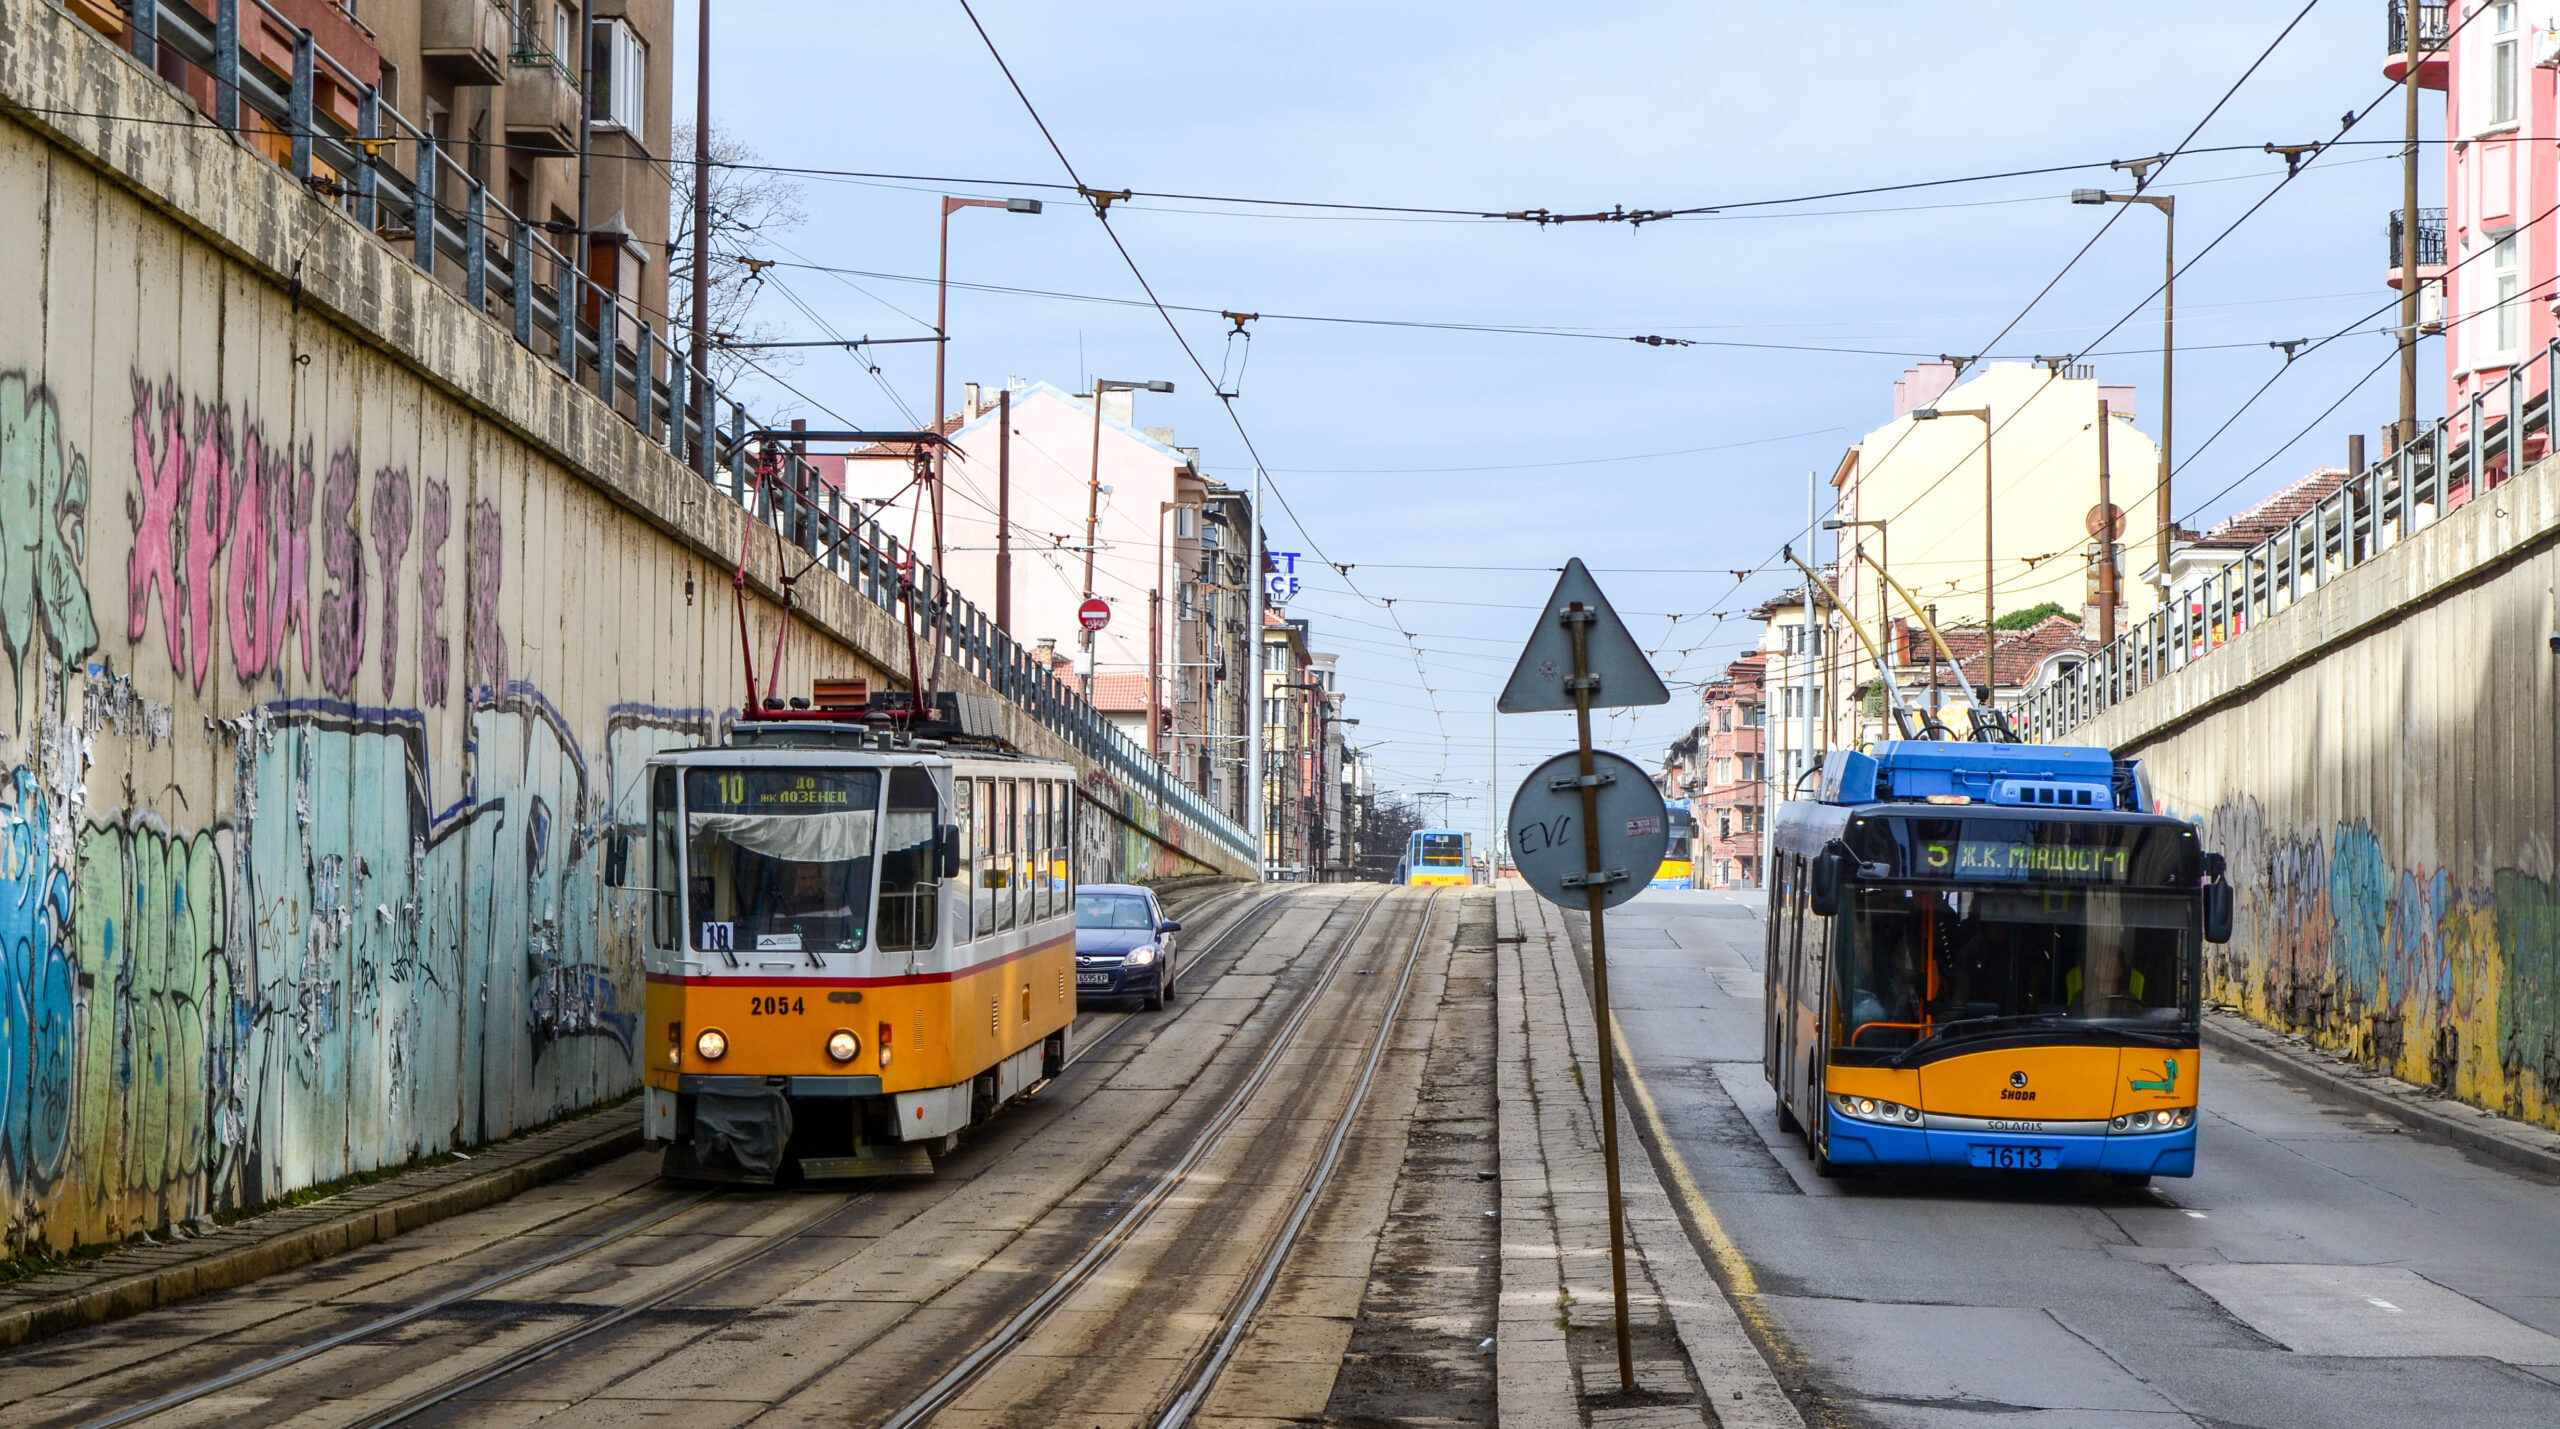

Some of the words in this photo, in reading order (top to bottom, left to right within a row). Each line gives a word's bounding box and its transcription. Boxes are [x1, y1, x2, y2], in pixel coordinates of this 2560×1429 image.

[718, 774, 744, 804] 10
[795, 777, 815, 789] ДО
[780, 791, 848, 804] ЛОЗЕНЕЦ
[707, 924, 728, 949] 10
[751, 996, 804, 1015] 2054
[2000, 1088, 2036, 1101] ŠKODA
[1987, 1120, 2043, 1132] SOLARIS
[1987, 1148, 2043, 1169] 1613
